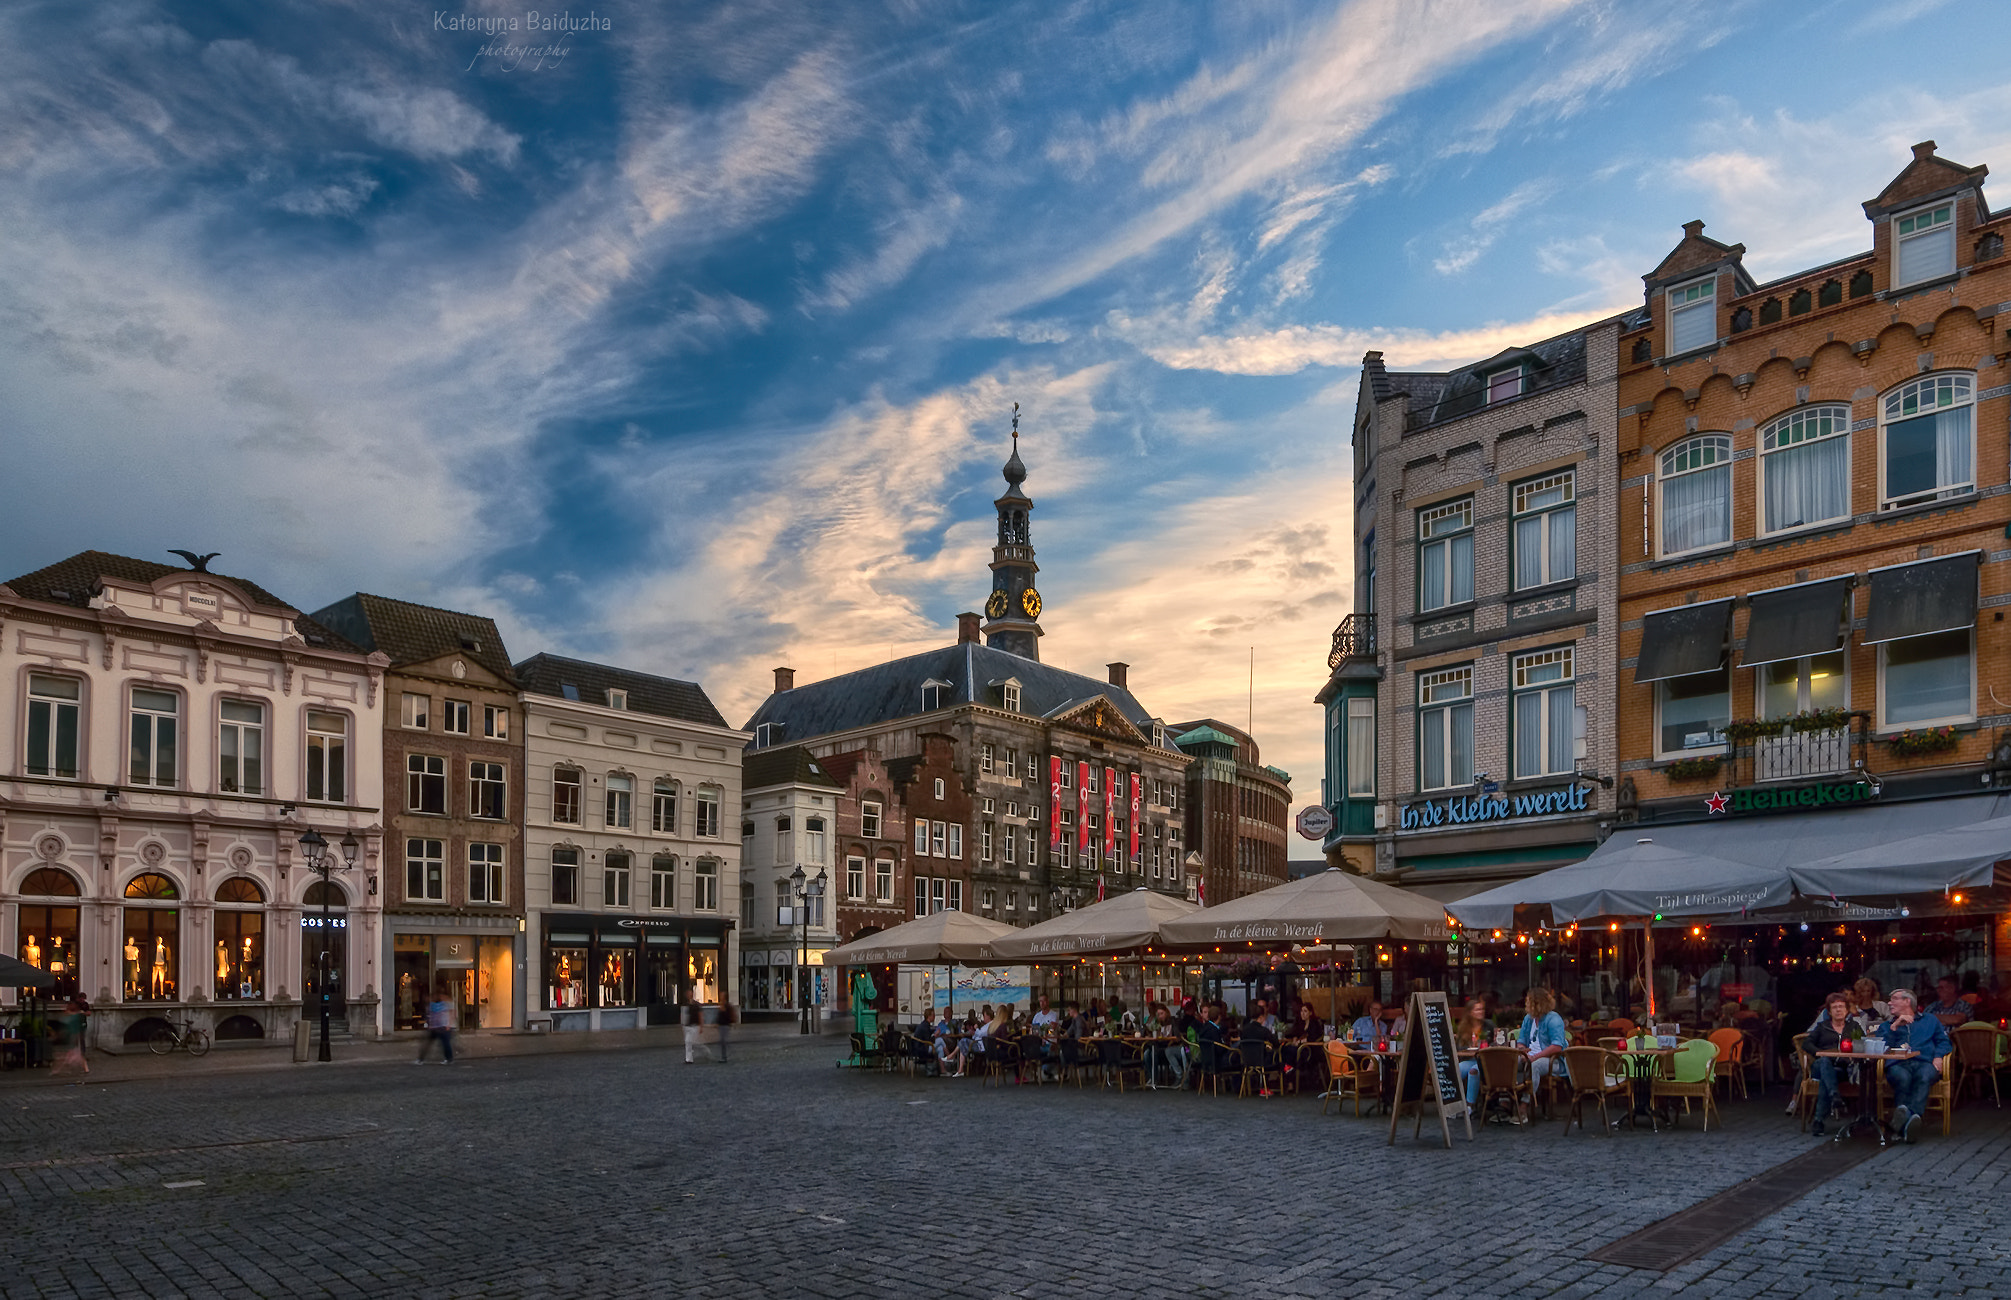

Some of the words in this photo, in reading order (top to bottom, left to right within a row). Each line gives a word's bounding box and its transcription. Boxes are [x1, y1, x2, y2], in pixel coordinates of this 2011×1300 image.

[1422, 801, 1445, 828] de
[1448, 794, 1510, 824] kleine
[1515, 783, 1592, 816] werelt
[1734, 782, 1871, 811] Heineken
[1685, 887, 1769, 907] Uilenspiegel
[1214, 927, 1226, 939] In
[1229, 925, 1243, 938] de
[1245, 923, 1279, 938] kleine
[1283, 921, 1324, 936] Werelt
[1029, 942, 1039, 953] In
[1040, 940, 1050, 952] de
[1051, 938, 1076, 951] kleine
[1078, 934, 1106, 949] Werelt
[849, 952, 857, 962] In
